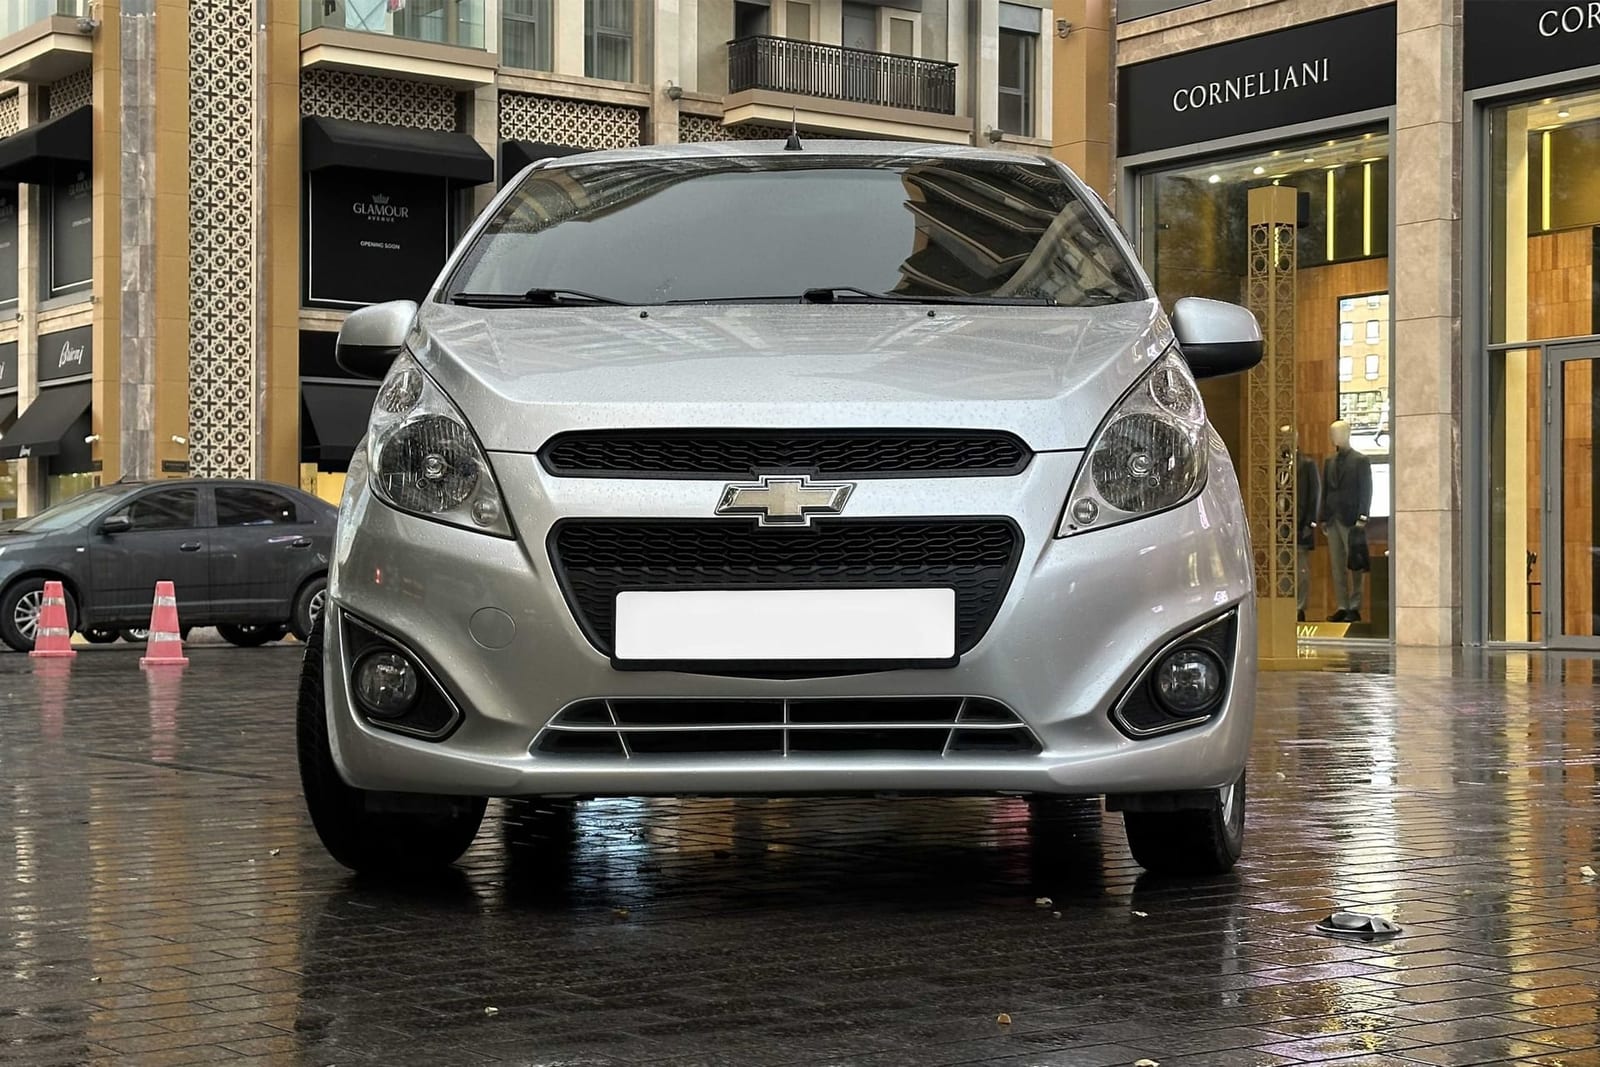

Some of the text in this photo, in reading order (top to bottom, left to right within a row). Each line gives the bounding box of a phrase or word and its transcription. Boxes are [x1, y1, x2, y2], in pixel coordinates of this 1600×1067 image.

[1538, 2, 1600, 37] COR
[1172, 58, 1329, 112] CORNELIANI
[353, 202, 408, 218] GLAMOUR
[360, 240, 384, 248] OPENING
